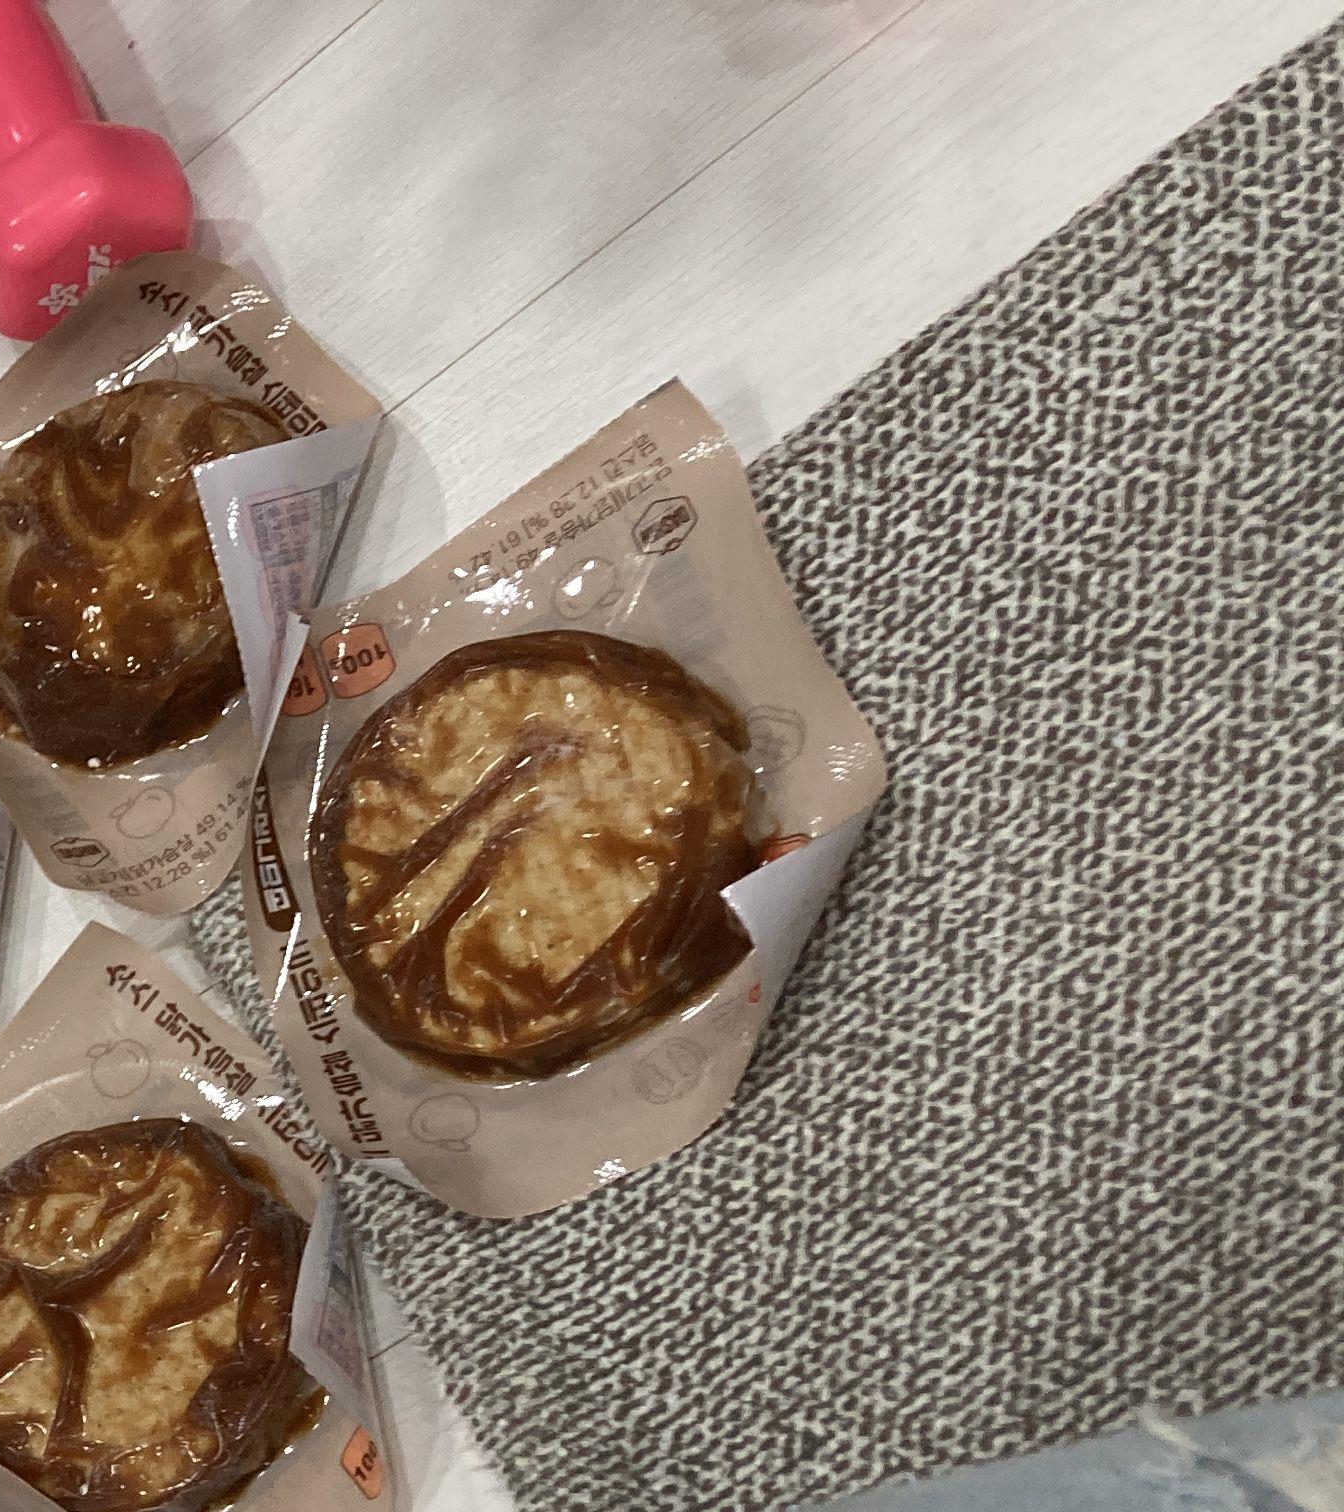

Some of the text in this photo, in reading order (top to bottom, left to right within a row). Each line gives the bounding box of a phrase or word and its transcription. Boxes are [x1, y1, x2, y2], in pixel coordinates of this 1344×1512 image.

[133, 273, 191, 318] 소스
[546, 474, 601, 519] 12.28
[103, 958, 163, 1013] 소스
[150, 998, 257, 1097] 닭가슴살
